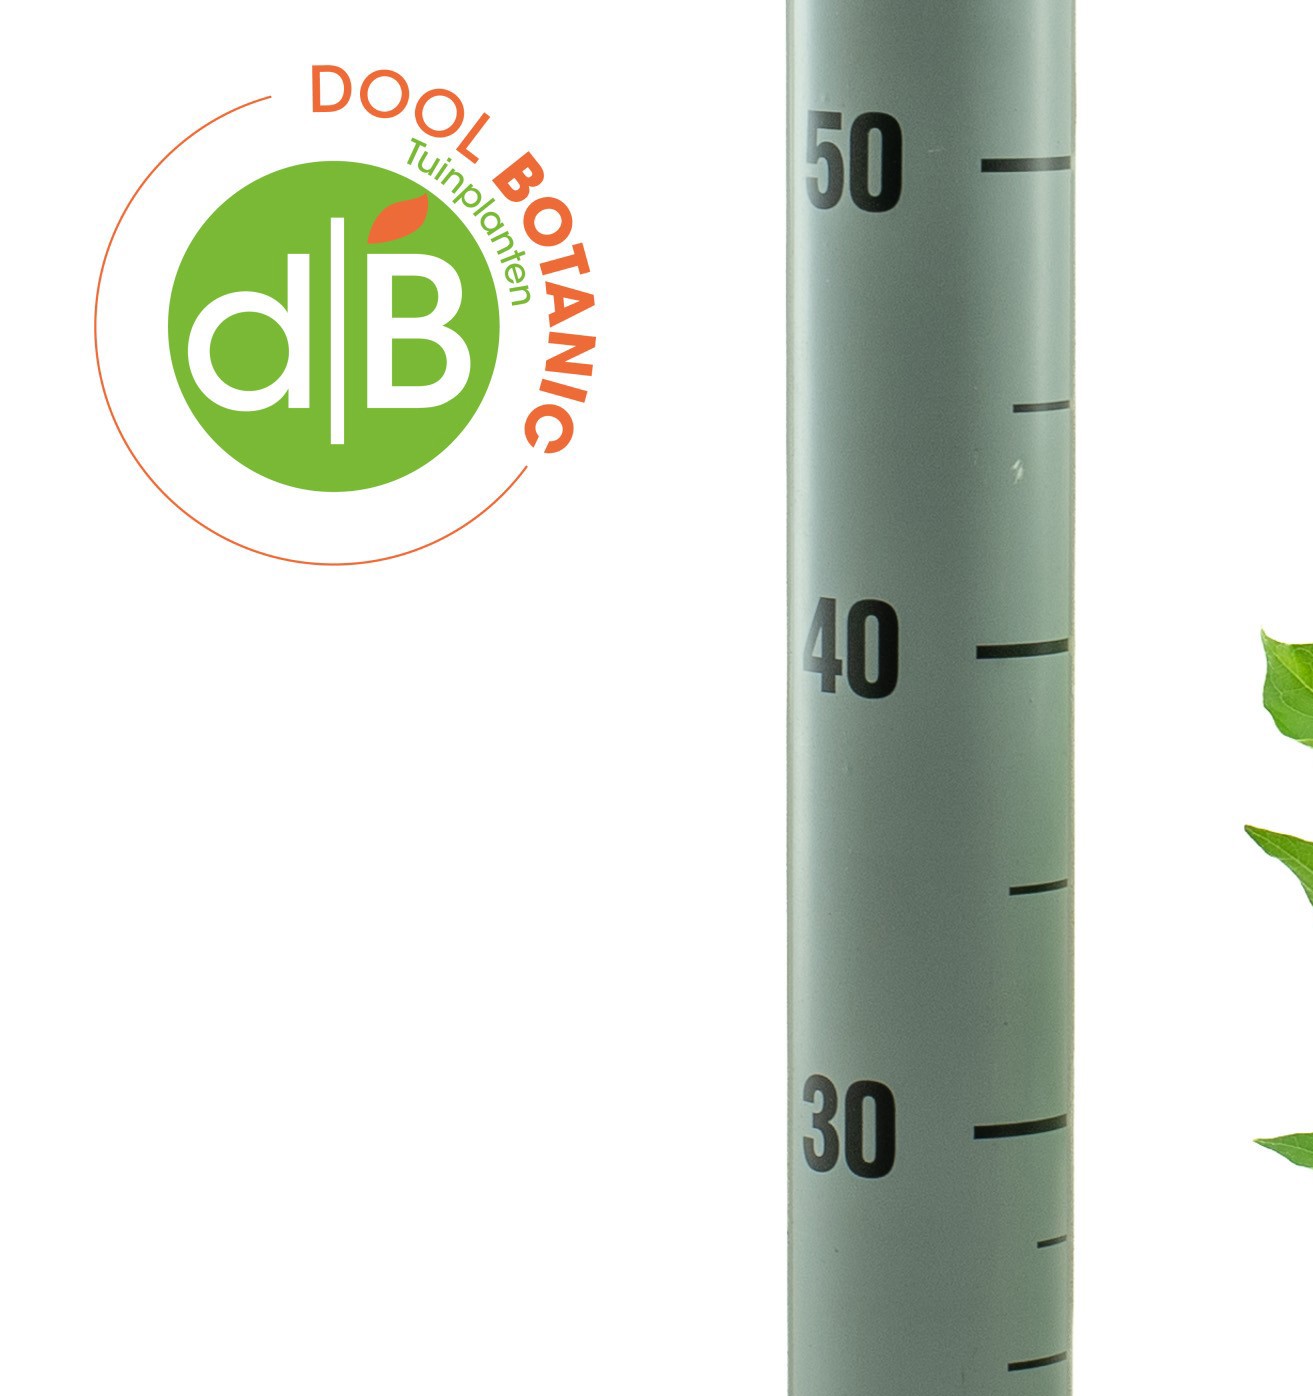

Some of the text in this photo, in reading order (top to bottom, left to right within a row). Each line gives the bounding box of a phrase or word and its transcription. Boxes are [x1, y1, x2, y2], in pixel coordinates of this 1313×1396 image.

[804, 110, 903, 213] 50
[803, 597, 900, 700] 40
[803, 1074, 896, 1179] 30
